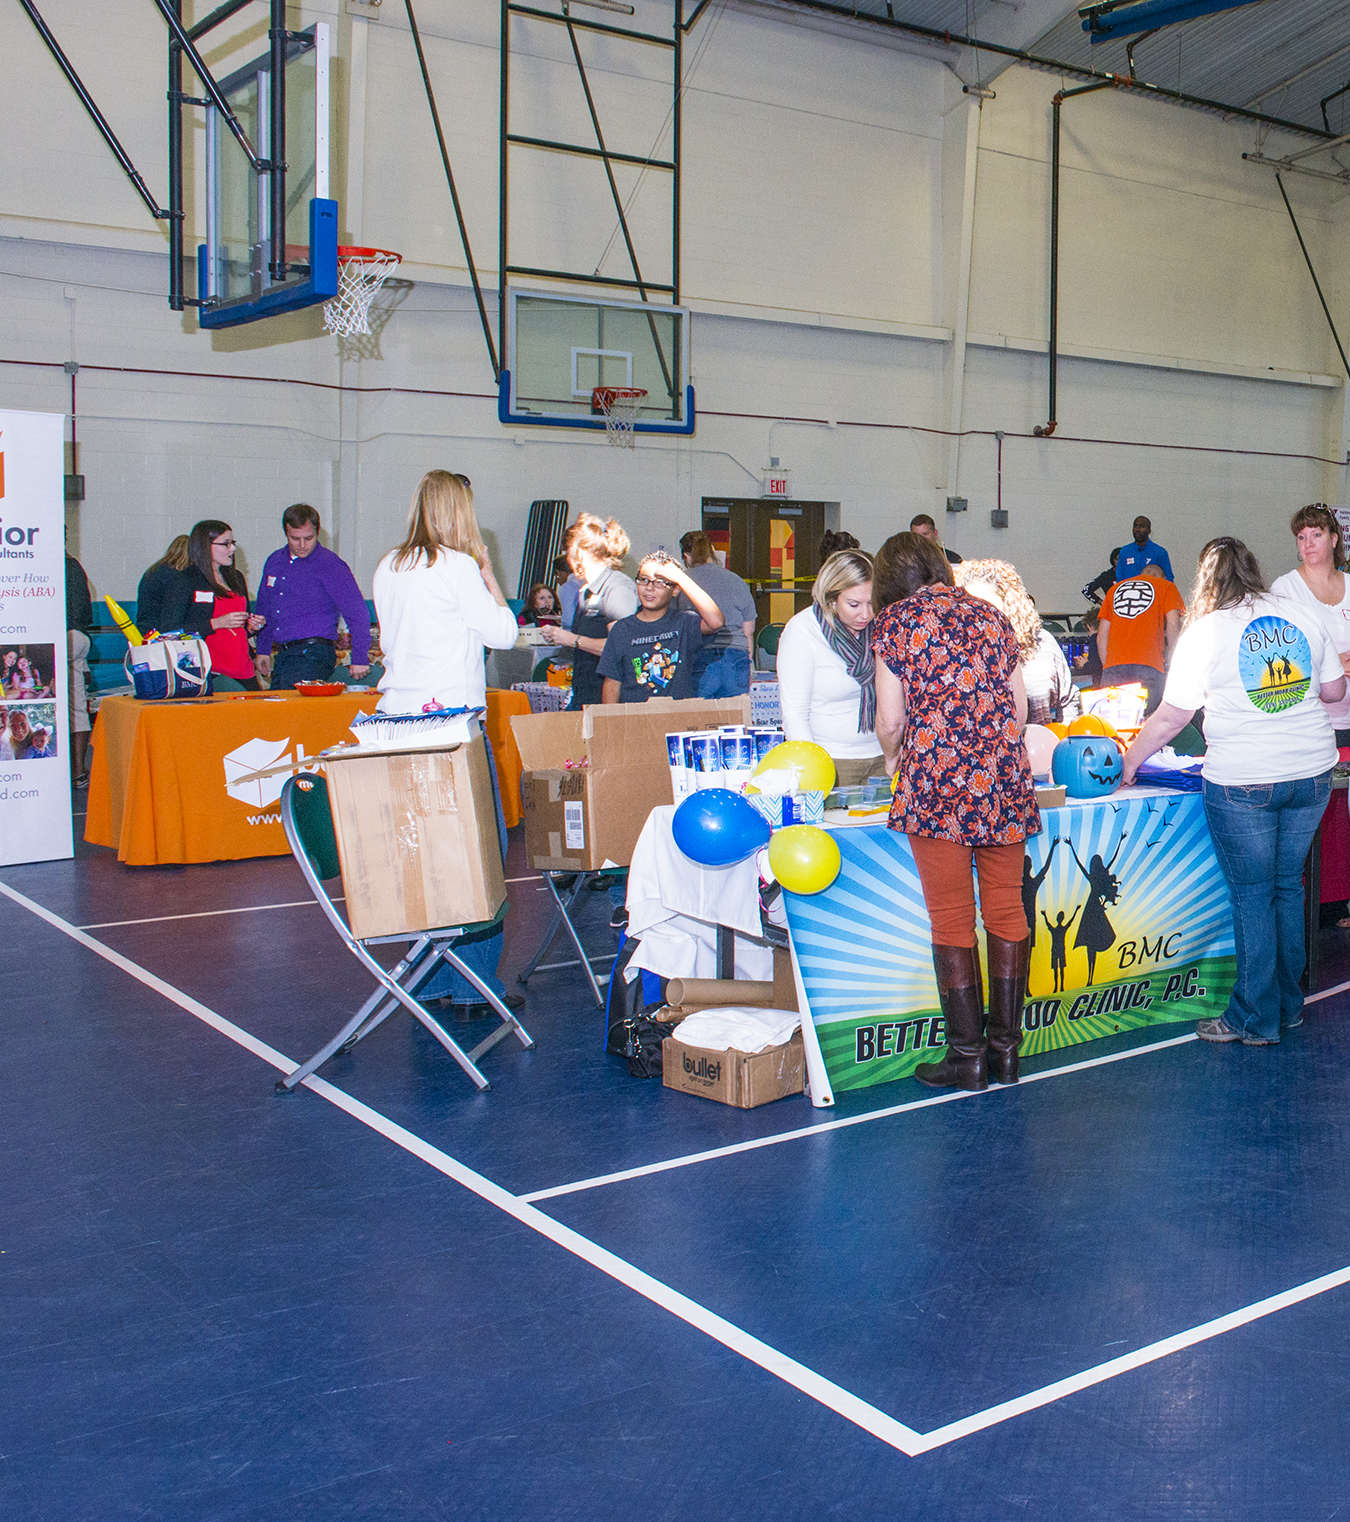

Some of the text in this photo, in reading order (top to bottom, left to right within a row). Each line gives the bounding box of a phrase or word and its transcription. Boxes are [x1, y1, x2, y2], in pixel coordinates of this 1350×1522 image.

[770, 479, 786, 493] EXIT
[23, 573, 50, 583] How
[23, 587, 56, 599] (ABA)
[631, 631, 679, 646] MINECRAFT
[1244, 625, 1297, 652] BMC
[754, 701, 780, 709] HONOR
[1117, 932, 1183, 969] BMC
[855, 1014, 949, 1064] BETTE
[1068, 979, 1153, 1021] CLINIC,
[1162, 967, 1206, 1003] P.C.
[682, 1052, 722, 1081] bullet
